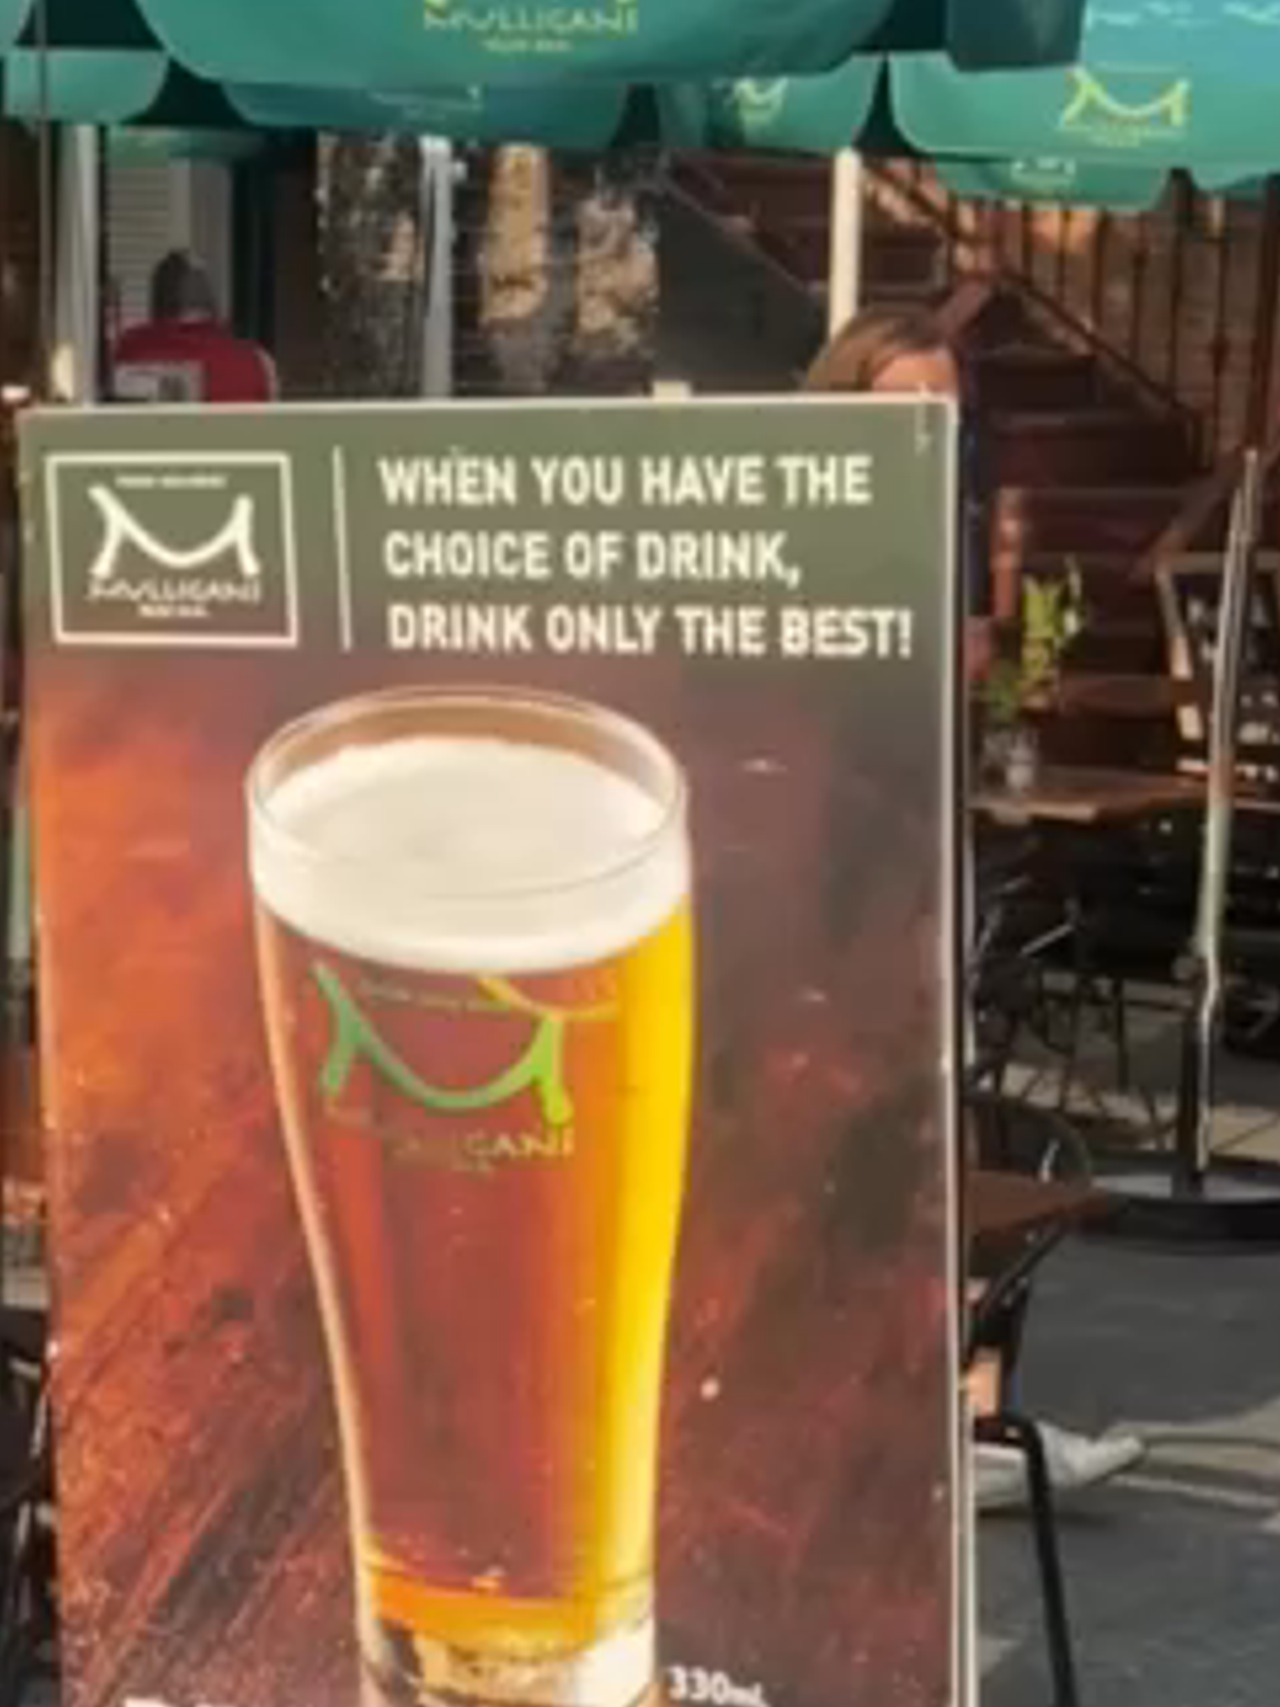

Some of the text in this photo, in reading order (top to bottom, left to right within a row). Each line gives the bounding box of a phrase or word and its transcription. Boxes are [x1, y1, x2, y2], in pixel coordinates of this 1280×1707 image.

[377, 453, 873, 507] WHEN YOU HAVE THE
[383, 529, 802, 589] CHOICE OF DRINK,
[387, 602, 913, 657] DRINK ONLY THE BEST!
